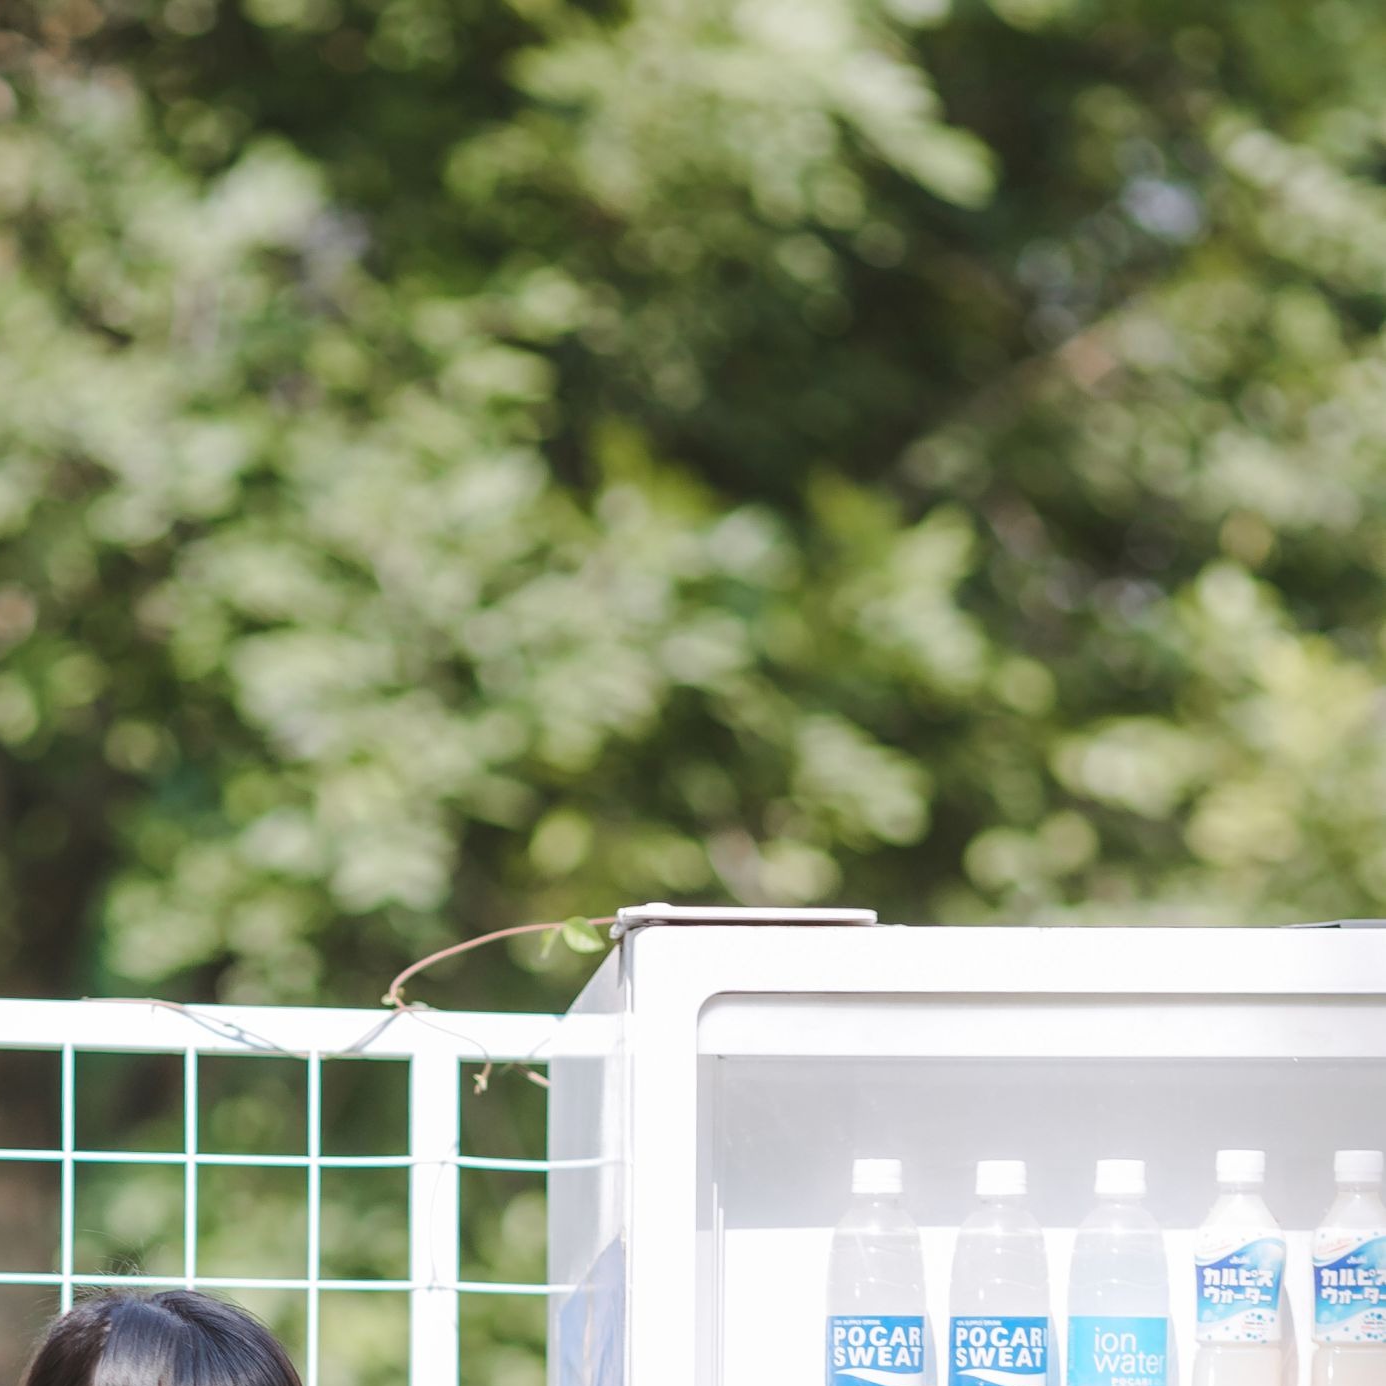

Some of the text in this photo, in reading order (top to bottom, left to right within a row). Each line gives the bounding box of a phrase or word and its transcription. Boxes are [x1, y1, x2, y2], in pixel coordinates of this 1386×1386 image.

[1202, 1267, 1274, 1287] カルピス
[833, 1326, 923, 1346] POCAR
[1094, 1326, 1136, 1353] ion
[833, 1346, 922, 1367] SWEAT
[955, 1347, 1044, 1368] SWEAT
[1093, 1351, 1165, 1375] water
